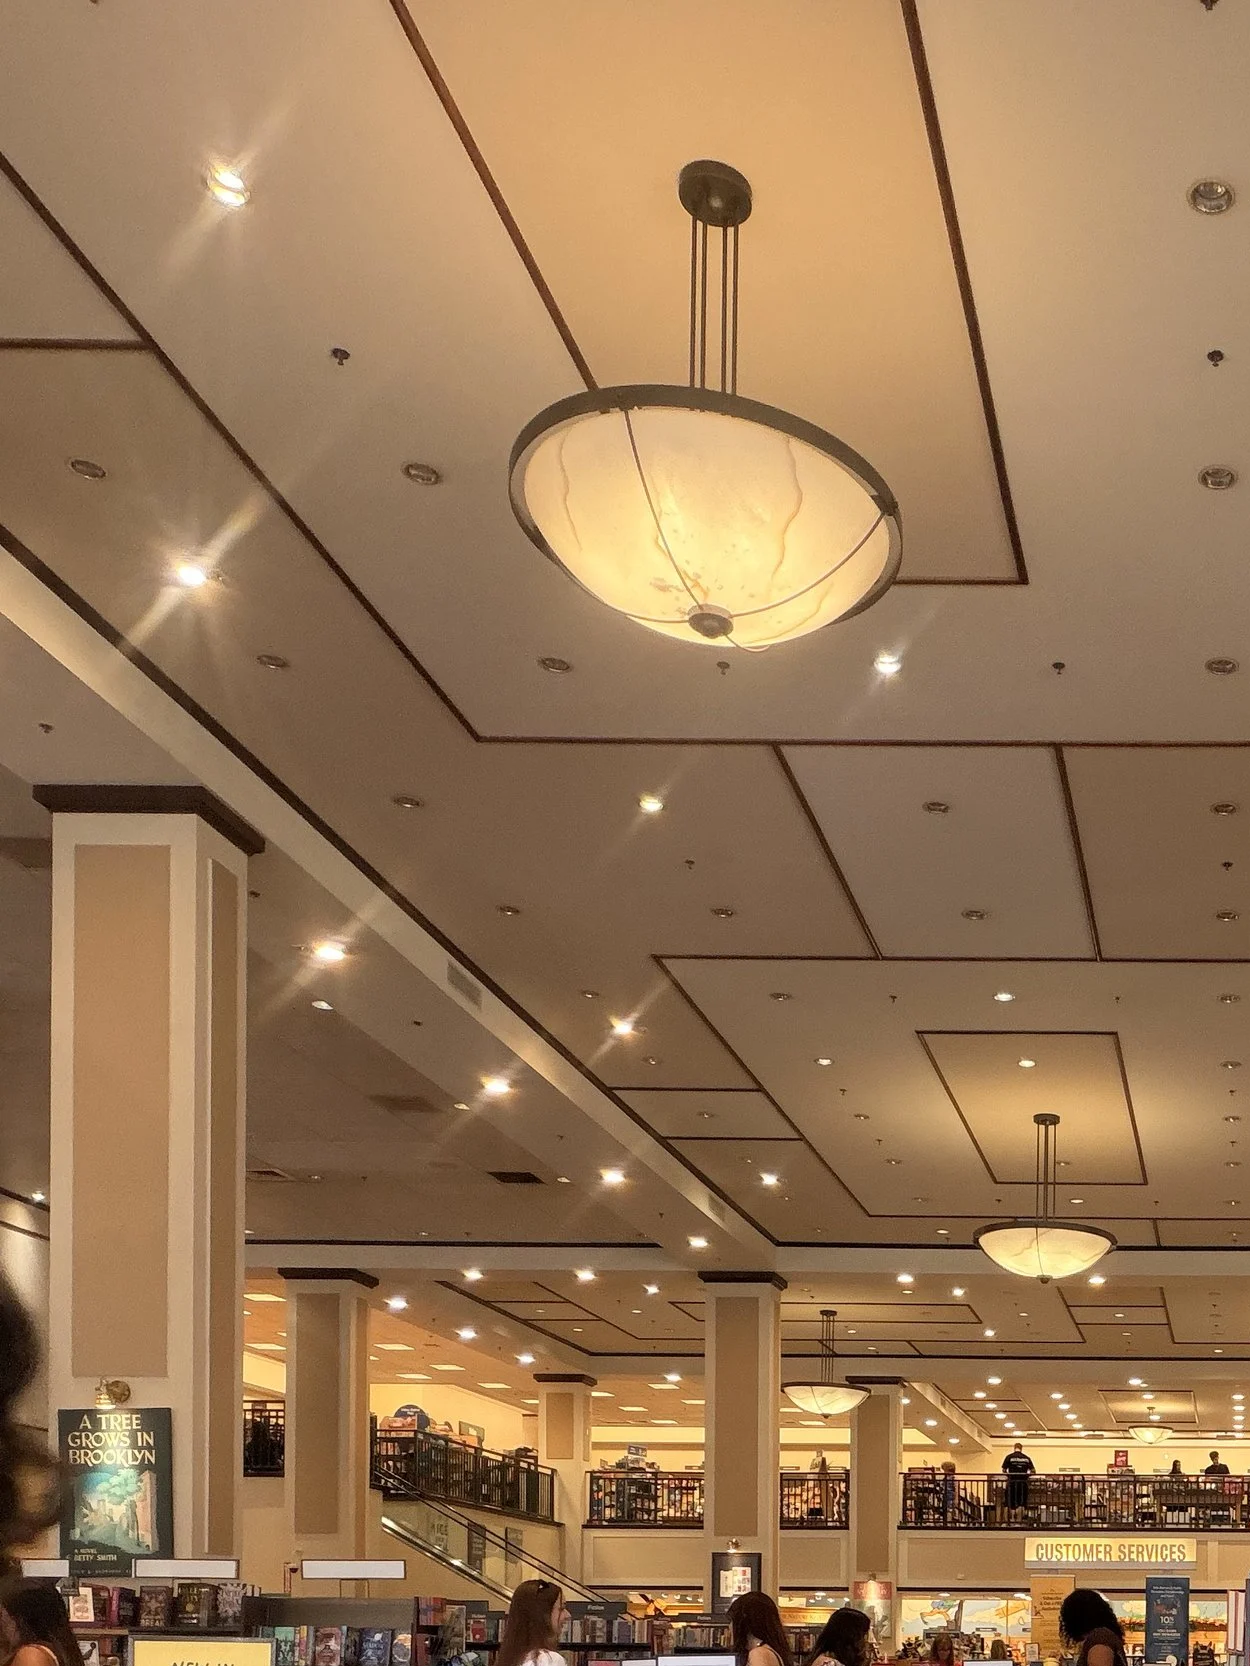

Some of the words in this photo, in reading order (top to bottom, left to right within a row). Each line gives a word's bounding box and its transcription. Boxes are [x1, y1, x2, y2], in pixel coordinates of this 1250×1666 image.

[79, 1414, 92, 1430] A
[97, 1414, 141, 1431] TREE
[68, 1431, 130, 1449] GROWS
[137, 1431, 154, 1447] IN
[69, 1449, 156, 1467] BROOKLYN
[1036, 1543, 1112, 1562] CUSTOMER
[1117, 1543, 1187, 1562] SERVICES
